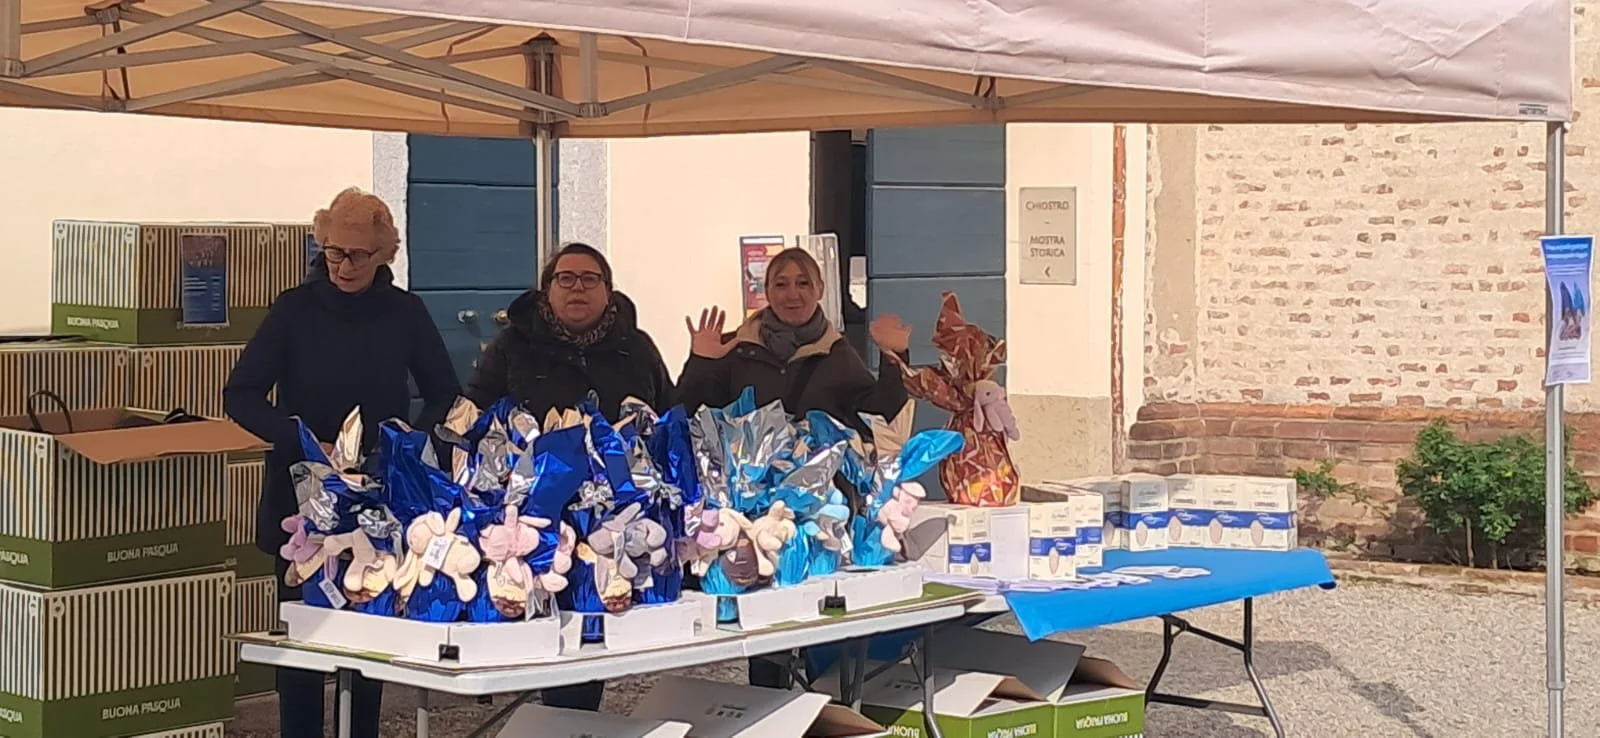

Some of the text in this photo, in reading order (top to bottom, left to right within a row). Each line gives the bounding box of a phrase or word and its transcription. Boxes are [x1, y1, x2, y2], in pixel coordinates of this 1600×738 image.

[1025, 200, 1070, 211] CHIOSTRO
[1030, 235, 1066, 245] MOSTRA
[1030, 247, 1066, 258] STORICA
[67, 316, 119, 330] BUONA PASQUA
[0, 550, 29, 566] ASQUA
[107, 543, 179, 563] BUONA PASQUA
[102, 697, 181, 720] BUONA PASQUA
[1075, 711, 1128, 729] BUONA PASQUA
[1013, 723, 1037, 737] BUONA
